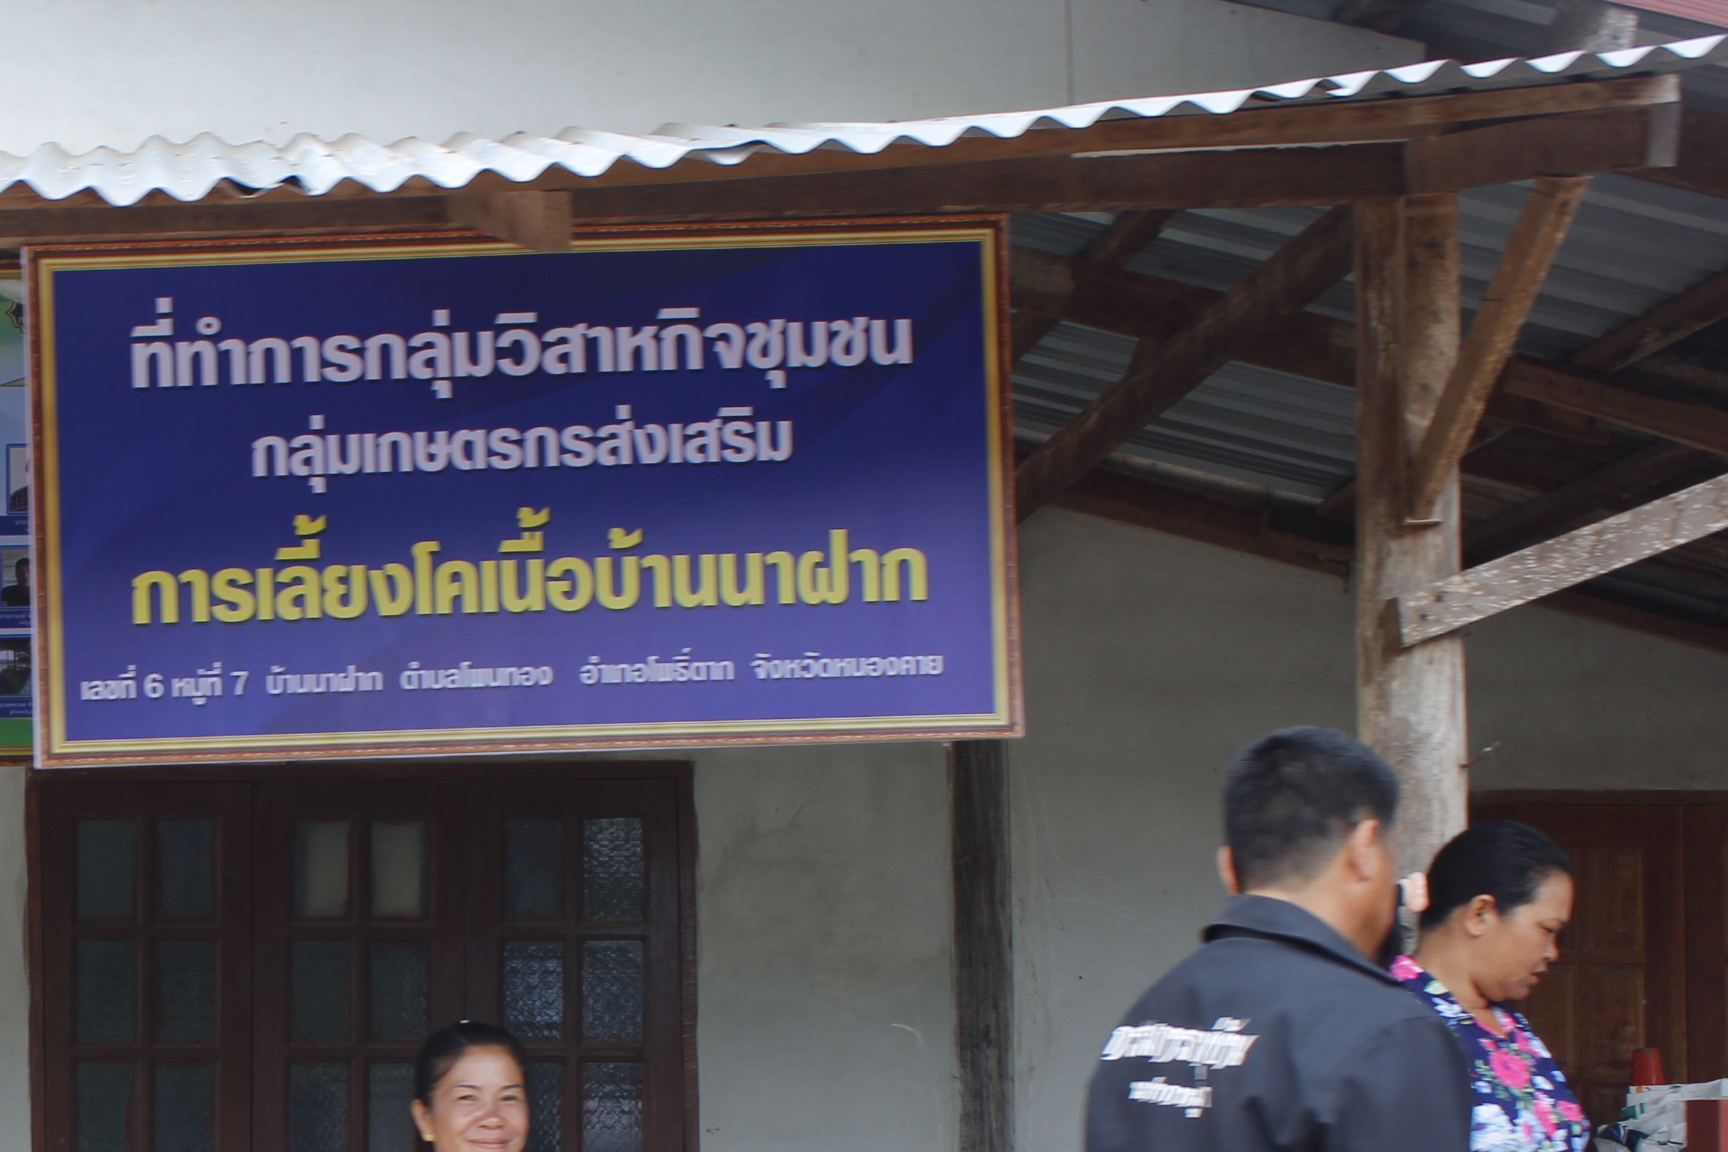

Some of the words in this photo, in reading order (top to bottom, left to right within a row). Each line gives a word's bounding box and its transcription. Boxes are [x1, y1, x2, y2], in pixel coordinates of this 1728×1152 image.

[130, 297, 914, 400] ที่ทำการกลุ่มวิสาหกิจชุมชน
[251, 404, 794, 494] กลุ่มเกษตรกรส่งเสริม
[130, 506, 929, 625] การเลี้ยงโคเนื้อบ้านนาฝาก
[80, 664, 138, 701] เลขที่
[143, 672, 165, 698] 6
[171, 661, 223, 705] หมู่ที่
[229, 670, 250, 696] 7
[265, 664, 385, 694] บ้านนาฝาก
[751, 652, 944, 680] จังหวัดหนองคาย
